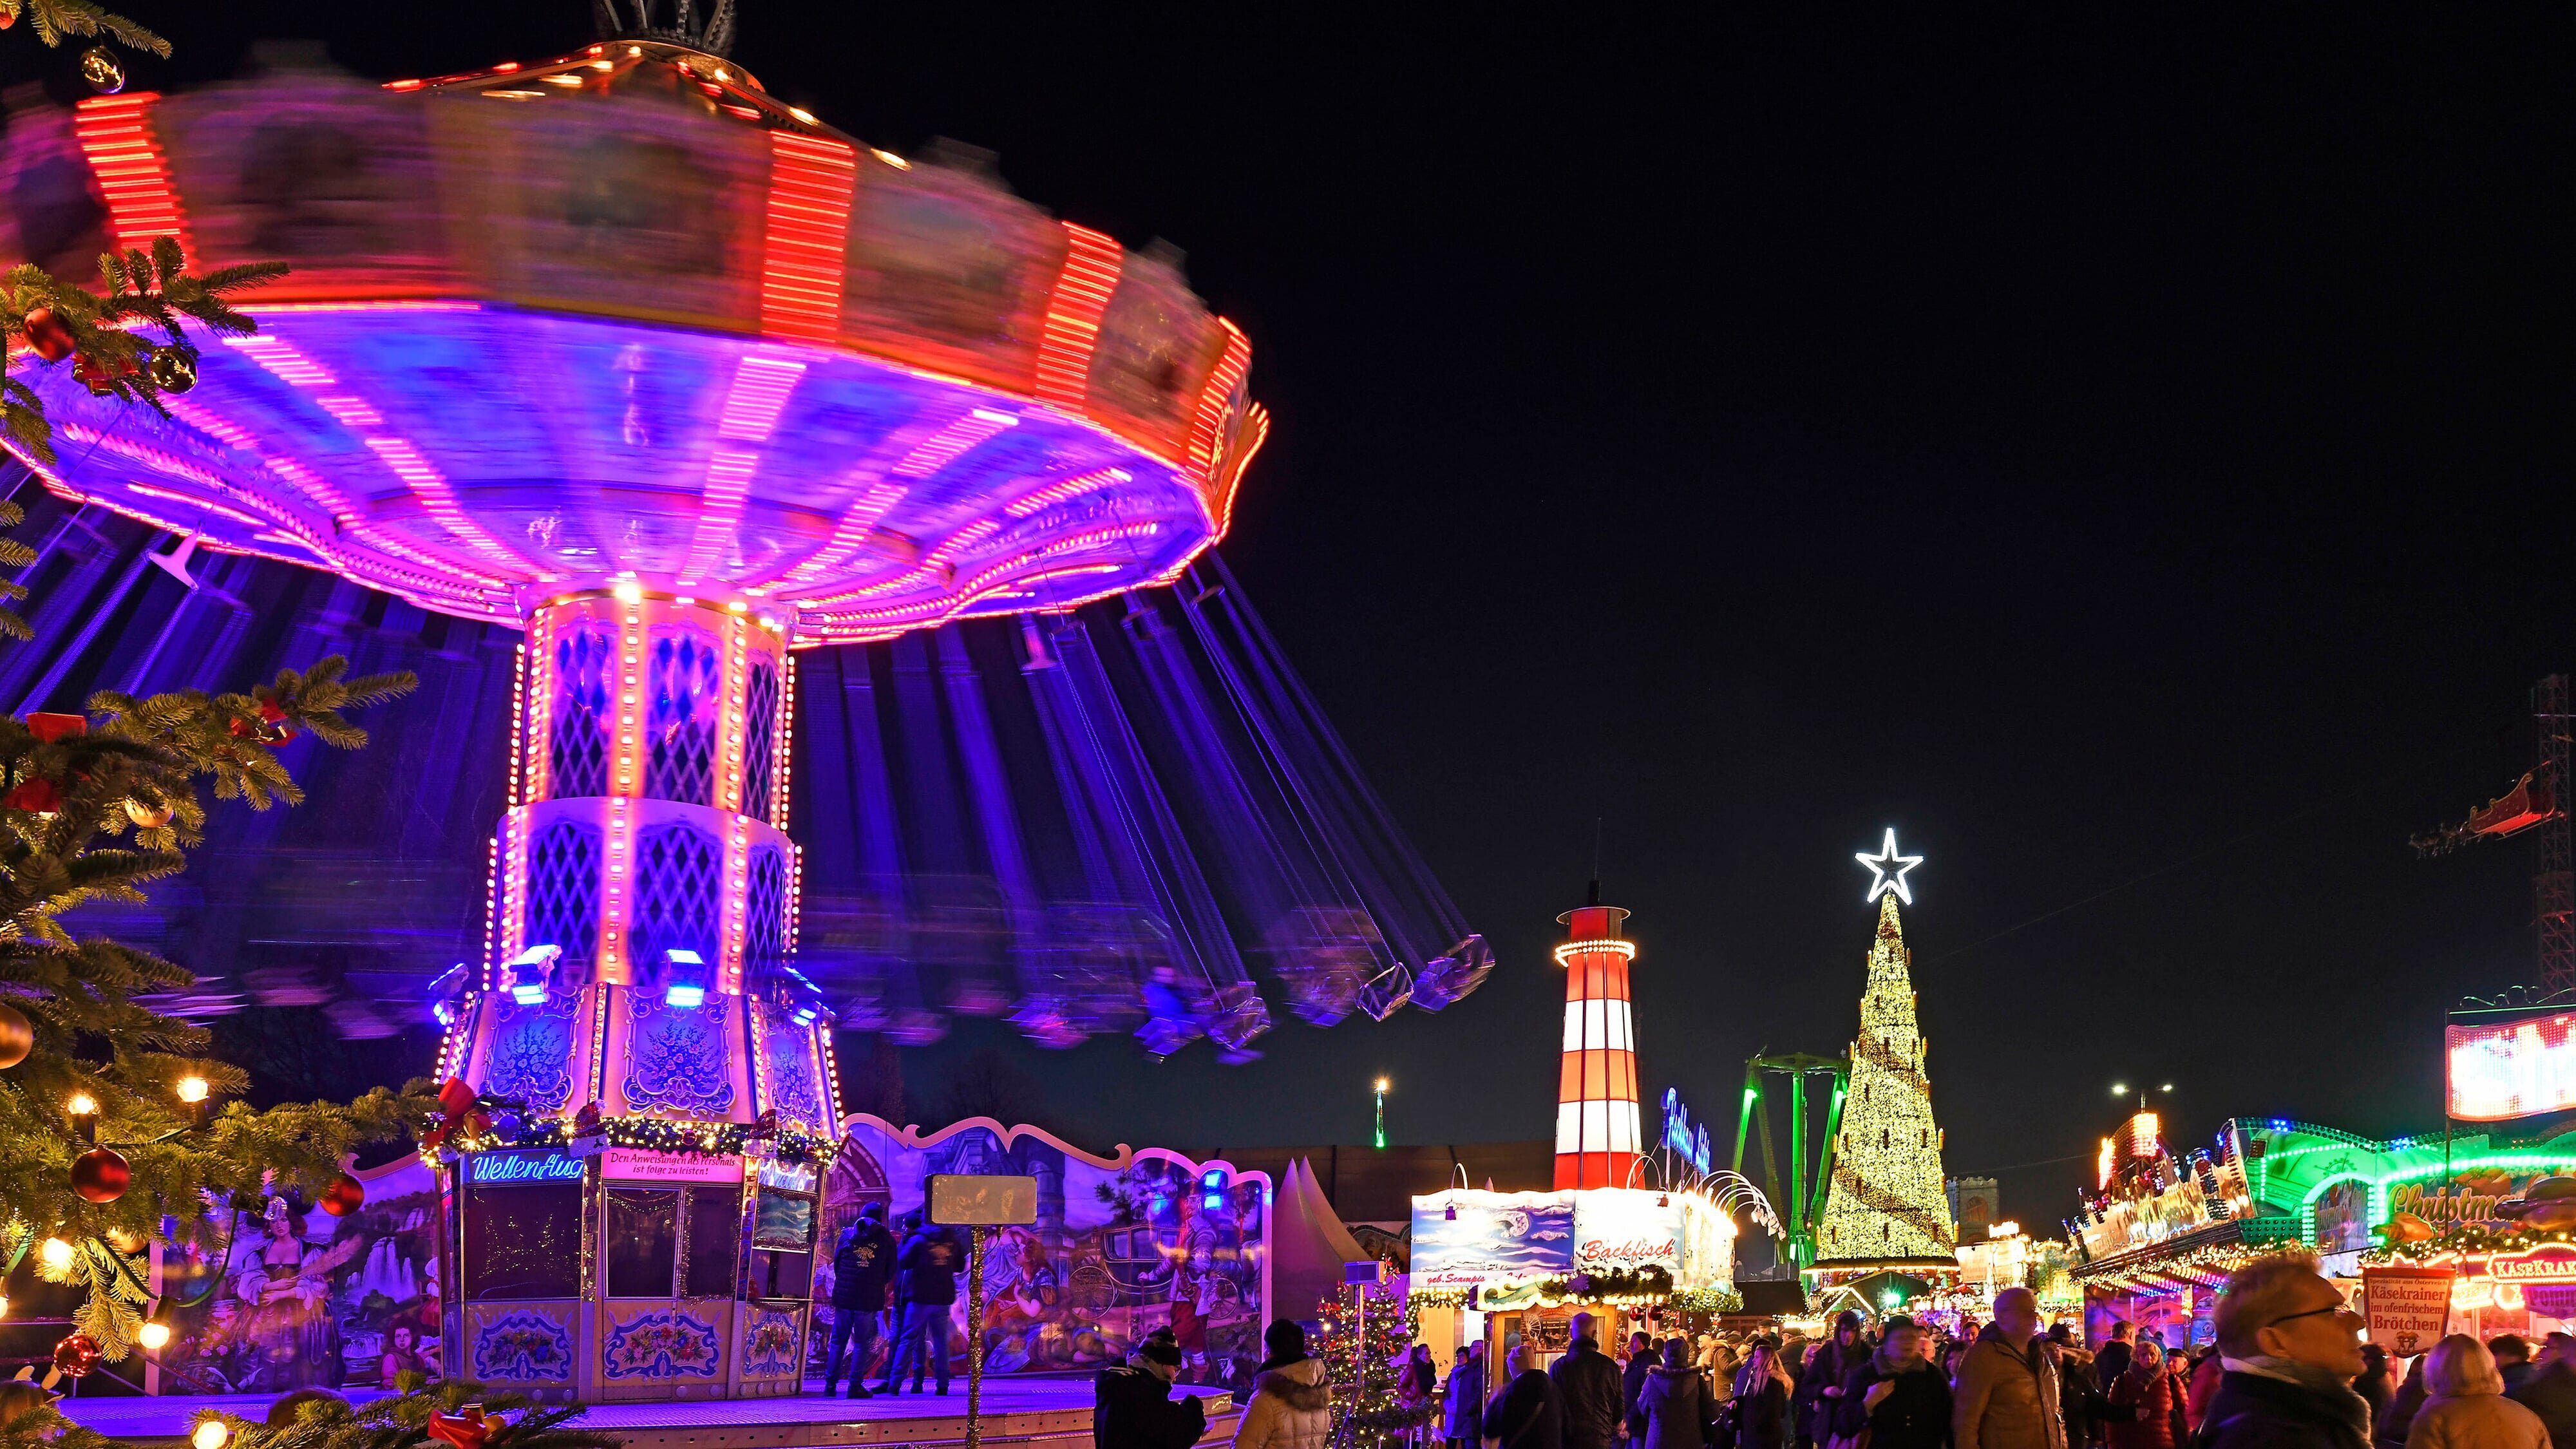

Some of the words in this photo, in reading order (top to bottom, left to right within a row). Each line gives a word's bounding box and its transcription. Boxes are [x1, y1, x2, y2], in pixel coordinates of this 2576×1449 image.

[472, 1154, 583, 1180] Wellenflug
[611, 1153, 629, 1163] Den
[630, 1153, 686, 1166] Anweisungen
[701, 1157, 735, 1166] Personals
[633, 1164, 645, 1173] ist
[647, 1165, 667, 1175] folge
[1586, 1238, 1675, 1264] Backfisch
[2371, 1285, 2445, 1301] Käsekrainer
[2371, 1303, 2382, 1312] im
[2384, 1302, 2443, 1314] ofenfrischem
[2374, 1315, 2438, 1331] Brötchen
